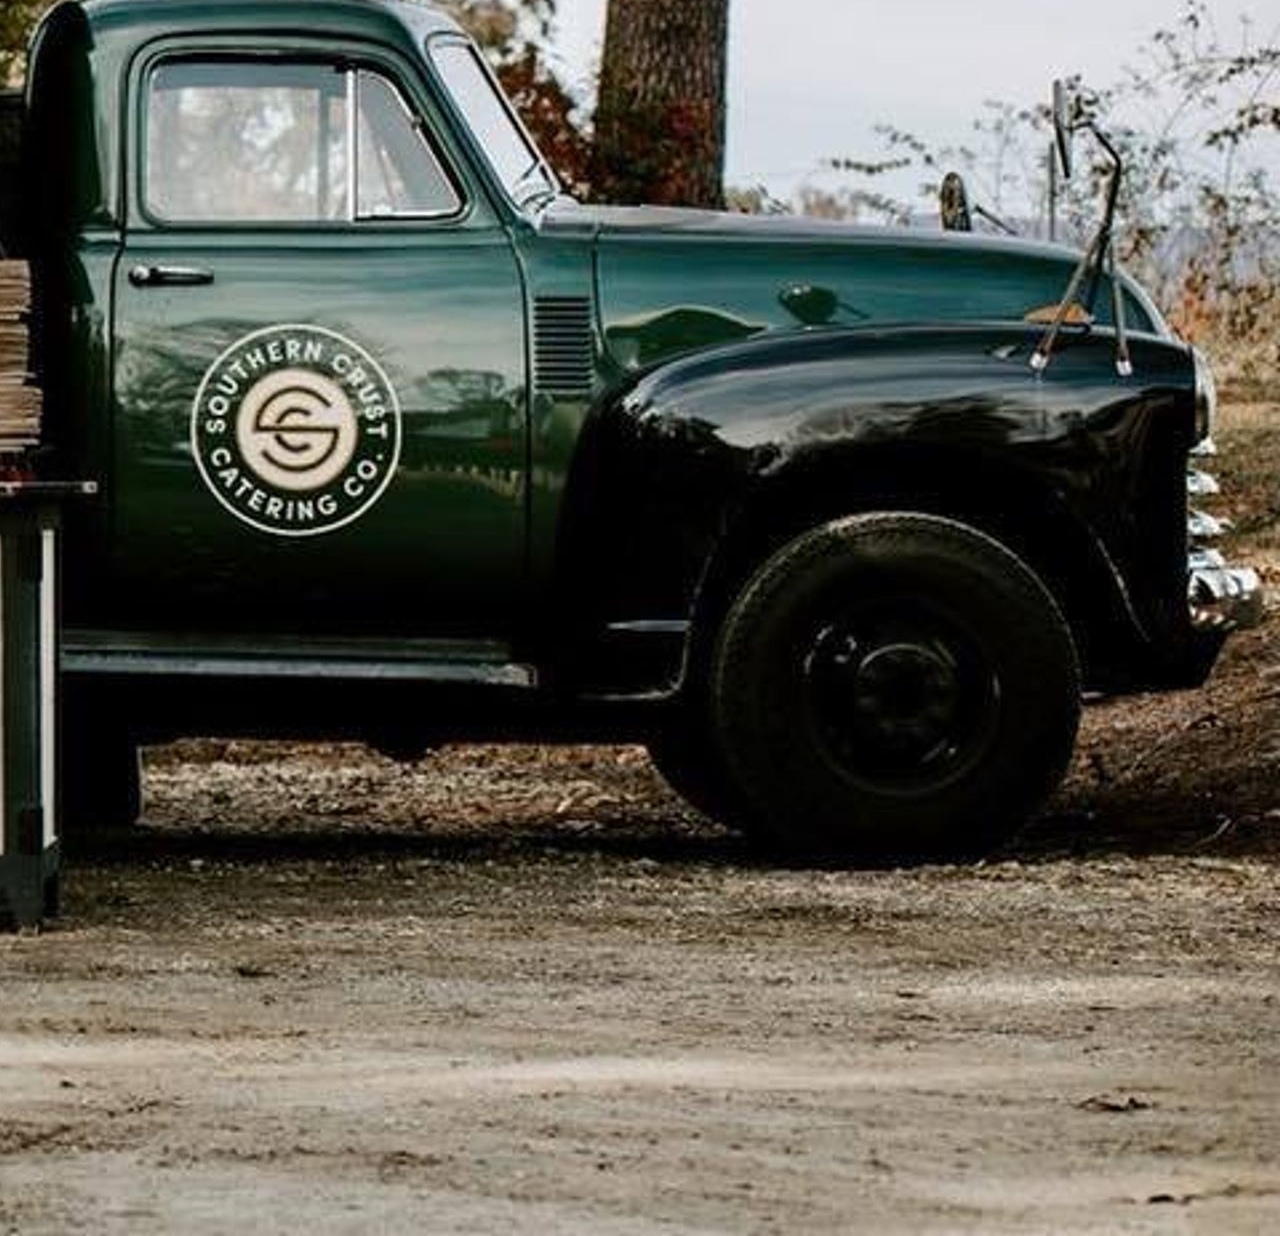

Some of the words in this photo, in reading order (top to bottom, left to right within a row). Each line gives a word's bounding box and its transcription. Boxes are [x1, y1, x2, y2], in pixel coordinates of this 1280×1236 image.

[206, 340, 322, 432] SOUTHERN
[332, 354, 387, 437] CRUST
[211, 448, 338, 520] CATERING
[344, 454, 383, 496] CO.
